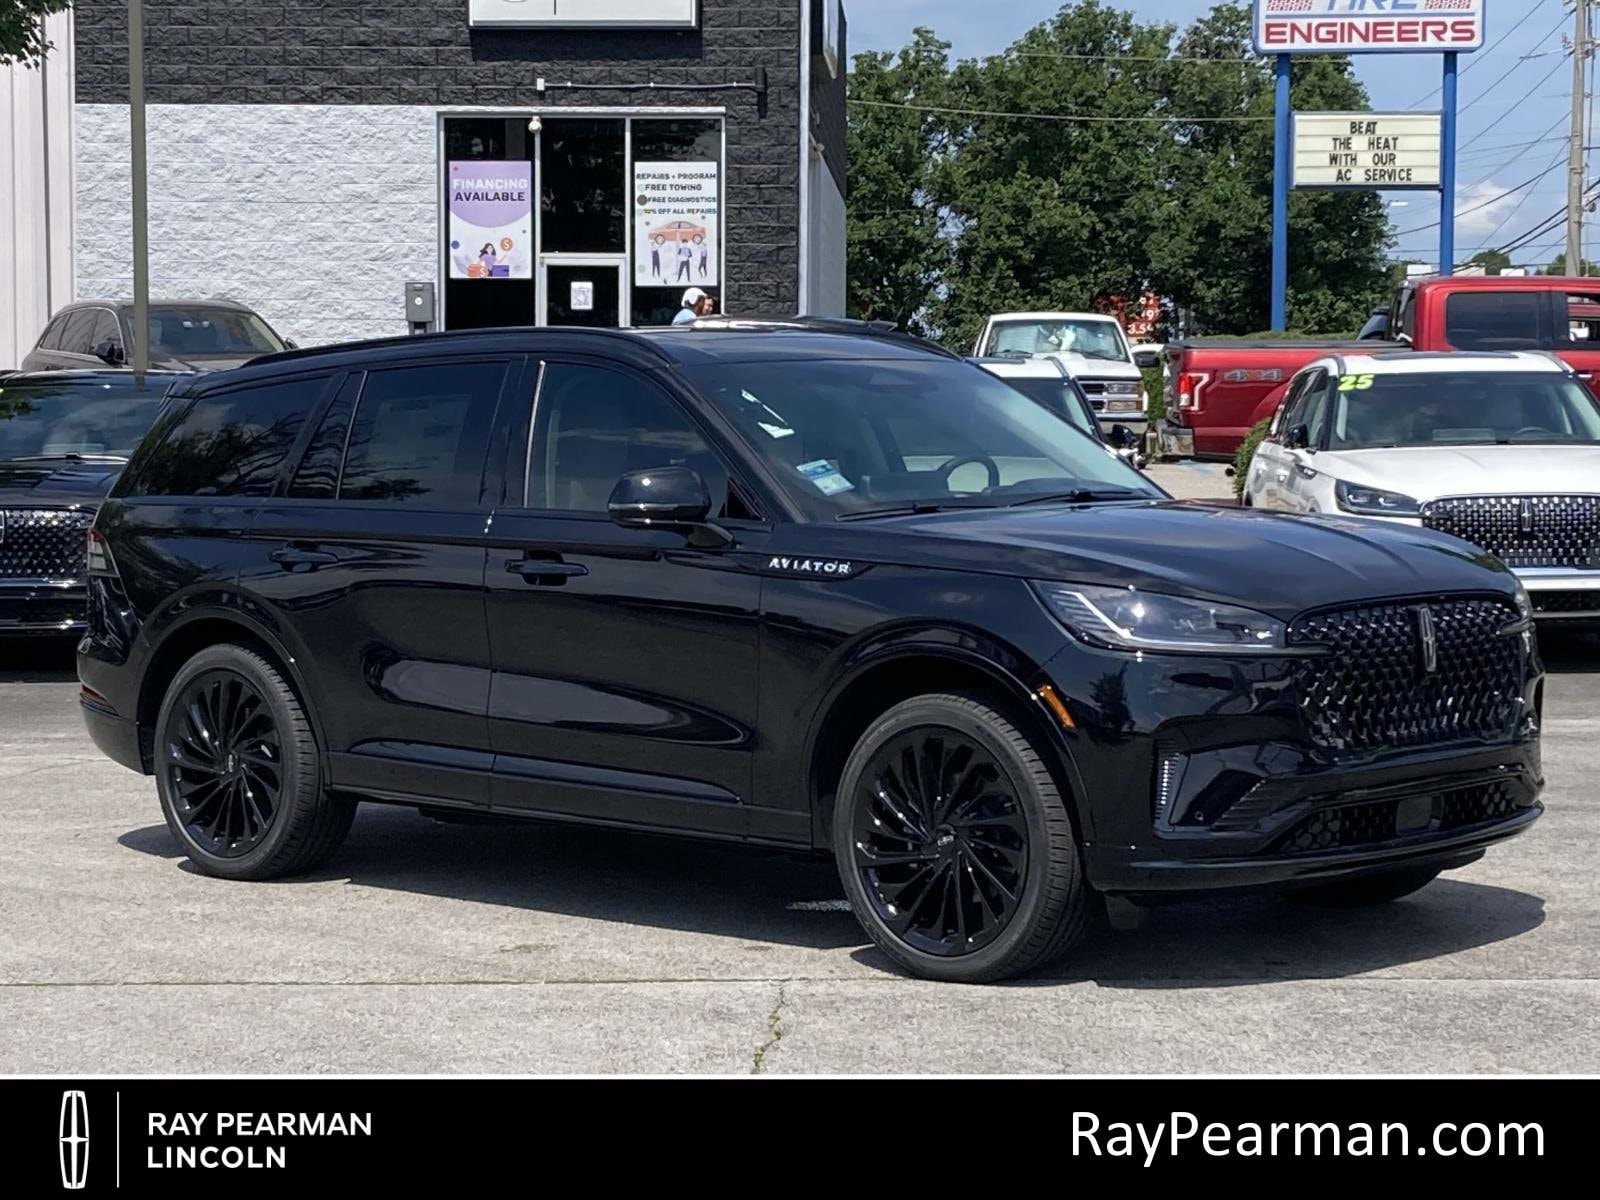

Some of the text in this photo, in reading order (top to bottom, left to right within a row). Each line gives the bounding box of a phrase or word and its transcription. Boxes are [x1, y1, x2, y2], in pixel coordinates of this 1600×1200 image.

[1265, 20, 1475, 44] ENGINEERS
[1349, 121, 1378, 135] BEAT
[1332, 136, 1399, 151] THE HEAT
[1328, 152, 1397, 166] WITH OUR
[1335, 168, 1413, 182] AC SERVICE
[452, 178, 528, 190] FINANCING
[645, 183, 702, 191] FREE TOWING
[454, 191, 526, 201] AVAILABLE
[1338, 374, 1375, 391] 25
[768, 557, 851, 573] AVIATOR
